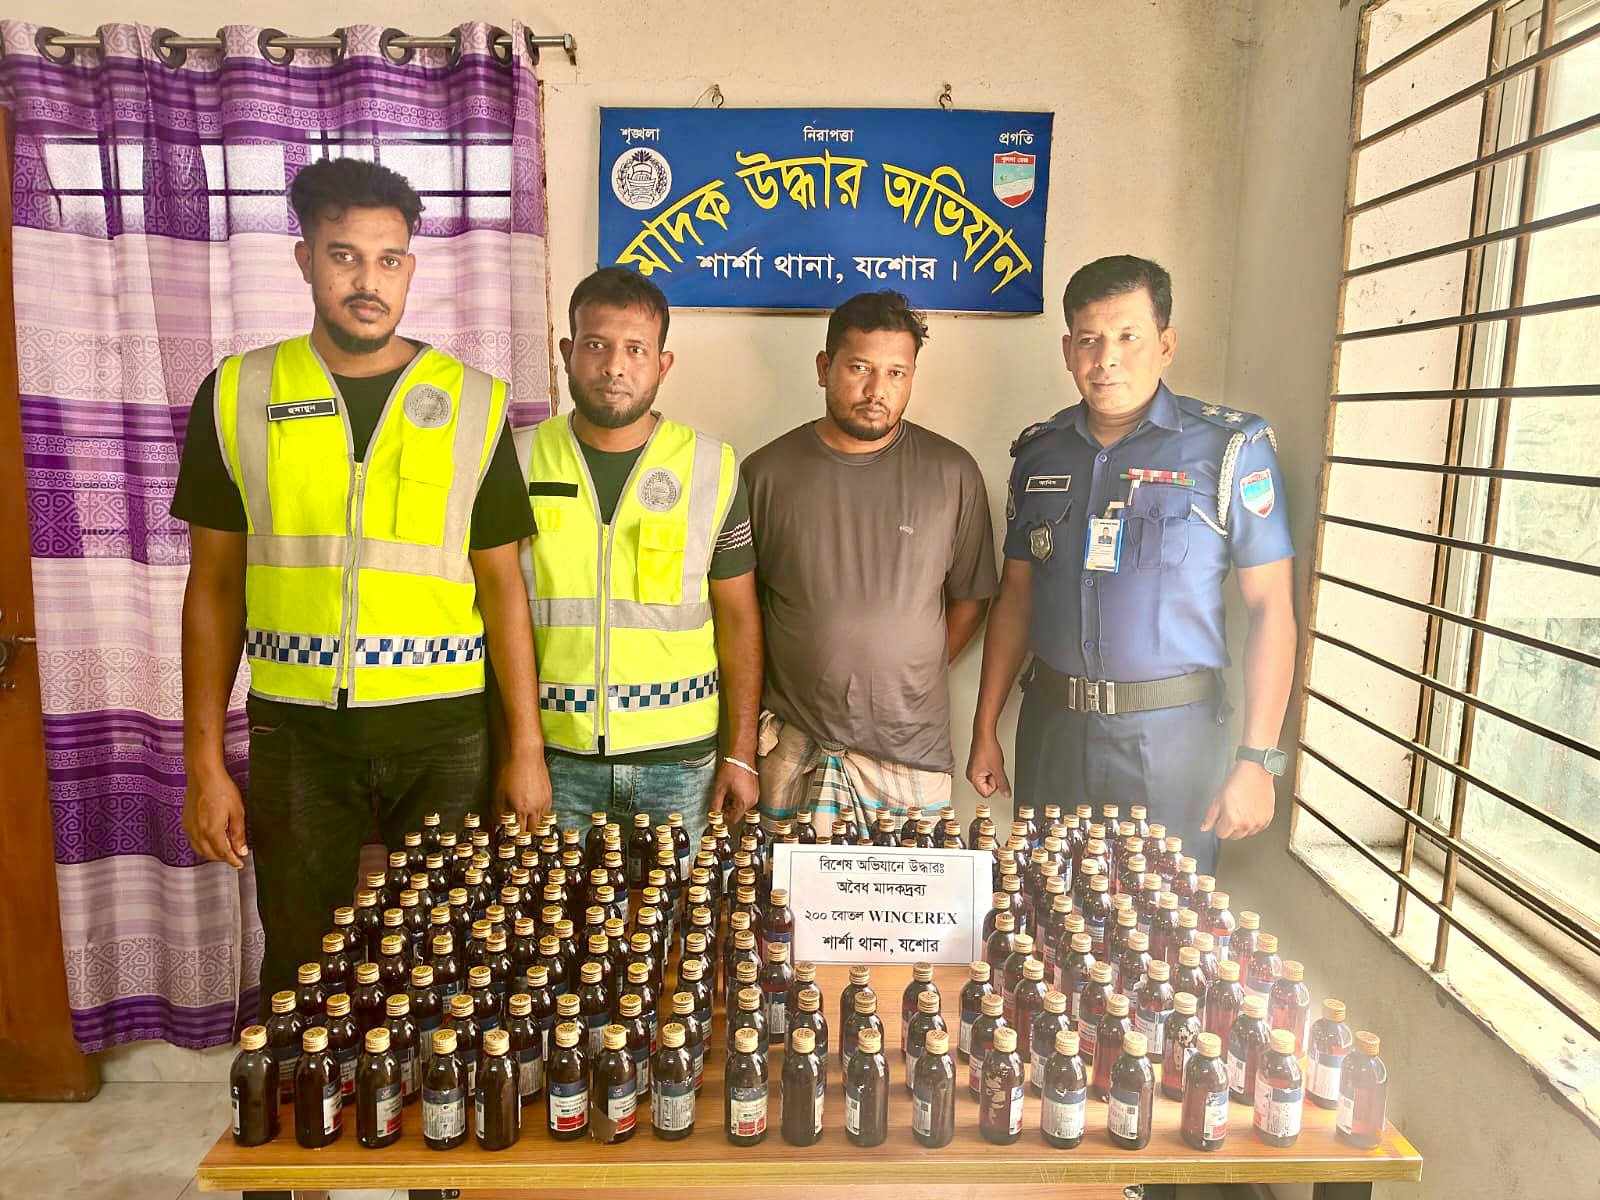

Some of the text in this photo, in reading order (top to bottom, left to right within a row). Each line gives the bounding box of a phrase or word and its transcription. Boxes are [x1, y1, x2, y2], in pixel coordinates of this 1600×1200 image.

[802, 125, 855, 143] নিরাপত্তা
[998, 129, 1036, 147] প্রগতি
[615, 148, 1033, 295] মাদক উদ্ধার অভিযান
[696, 246, 764, 280] শার্শা
[773, 252, 846, 285] থানা,
[852, 254, 938, 282] যশোর
[819, 855, 853, 872] বিশেষ
[856, 856, 905, 873] অভিযানে
[836, 878, 927, 897] অবৈধ মাদকদ্রব্য
[804, 909, 959, 925] ২০০ বোতল WINCEREX
[821, 931, 854, 951] শার্শা
[897, 937, 941, 953] যশোর
